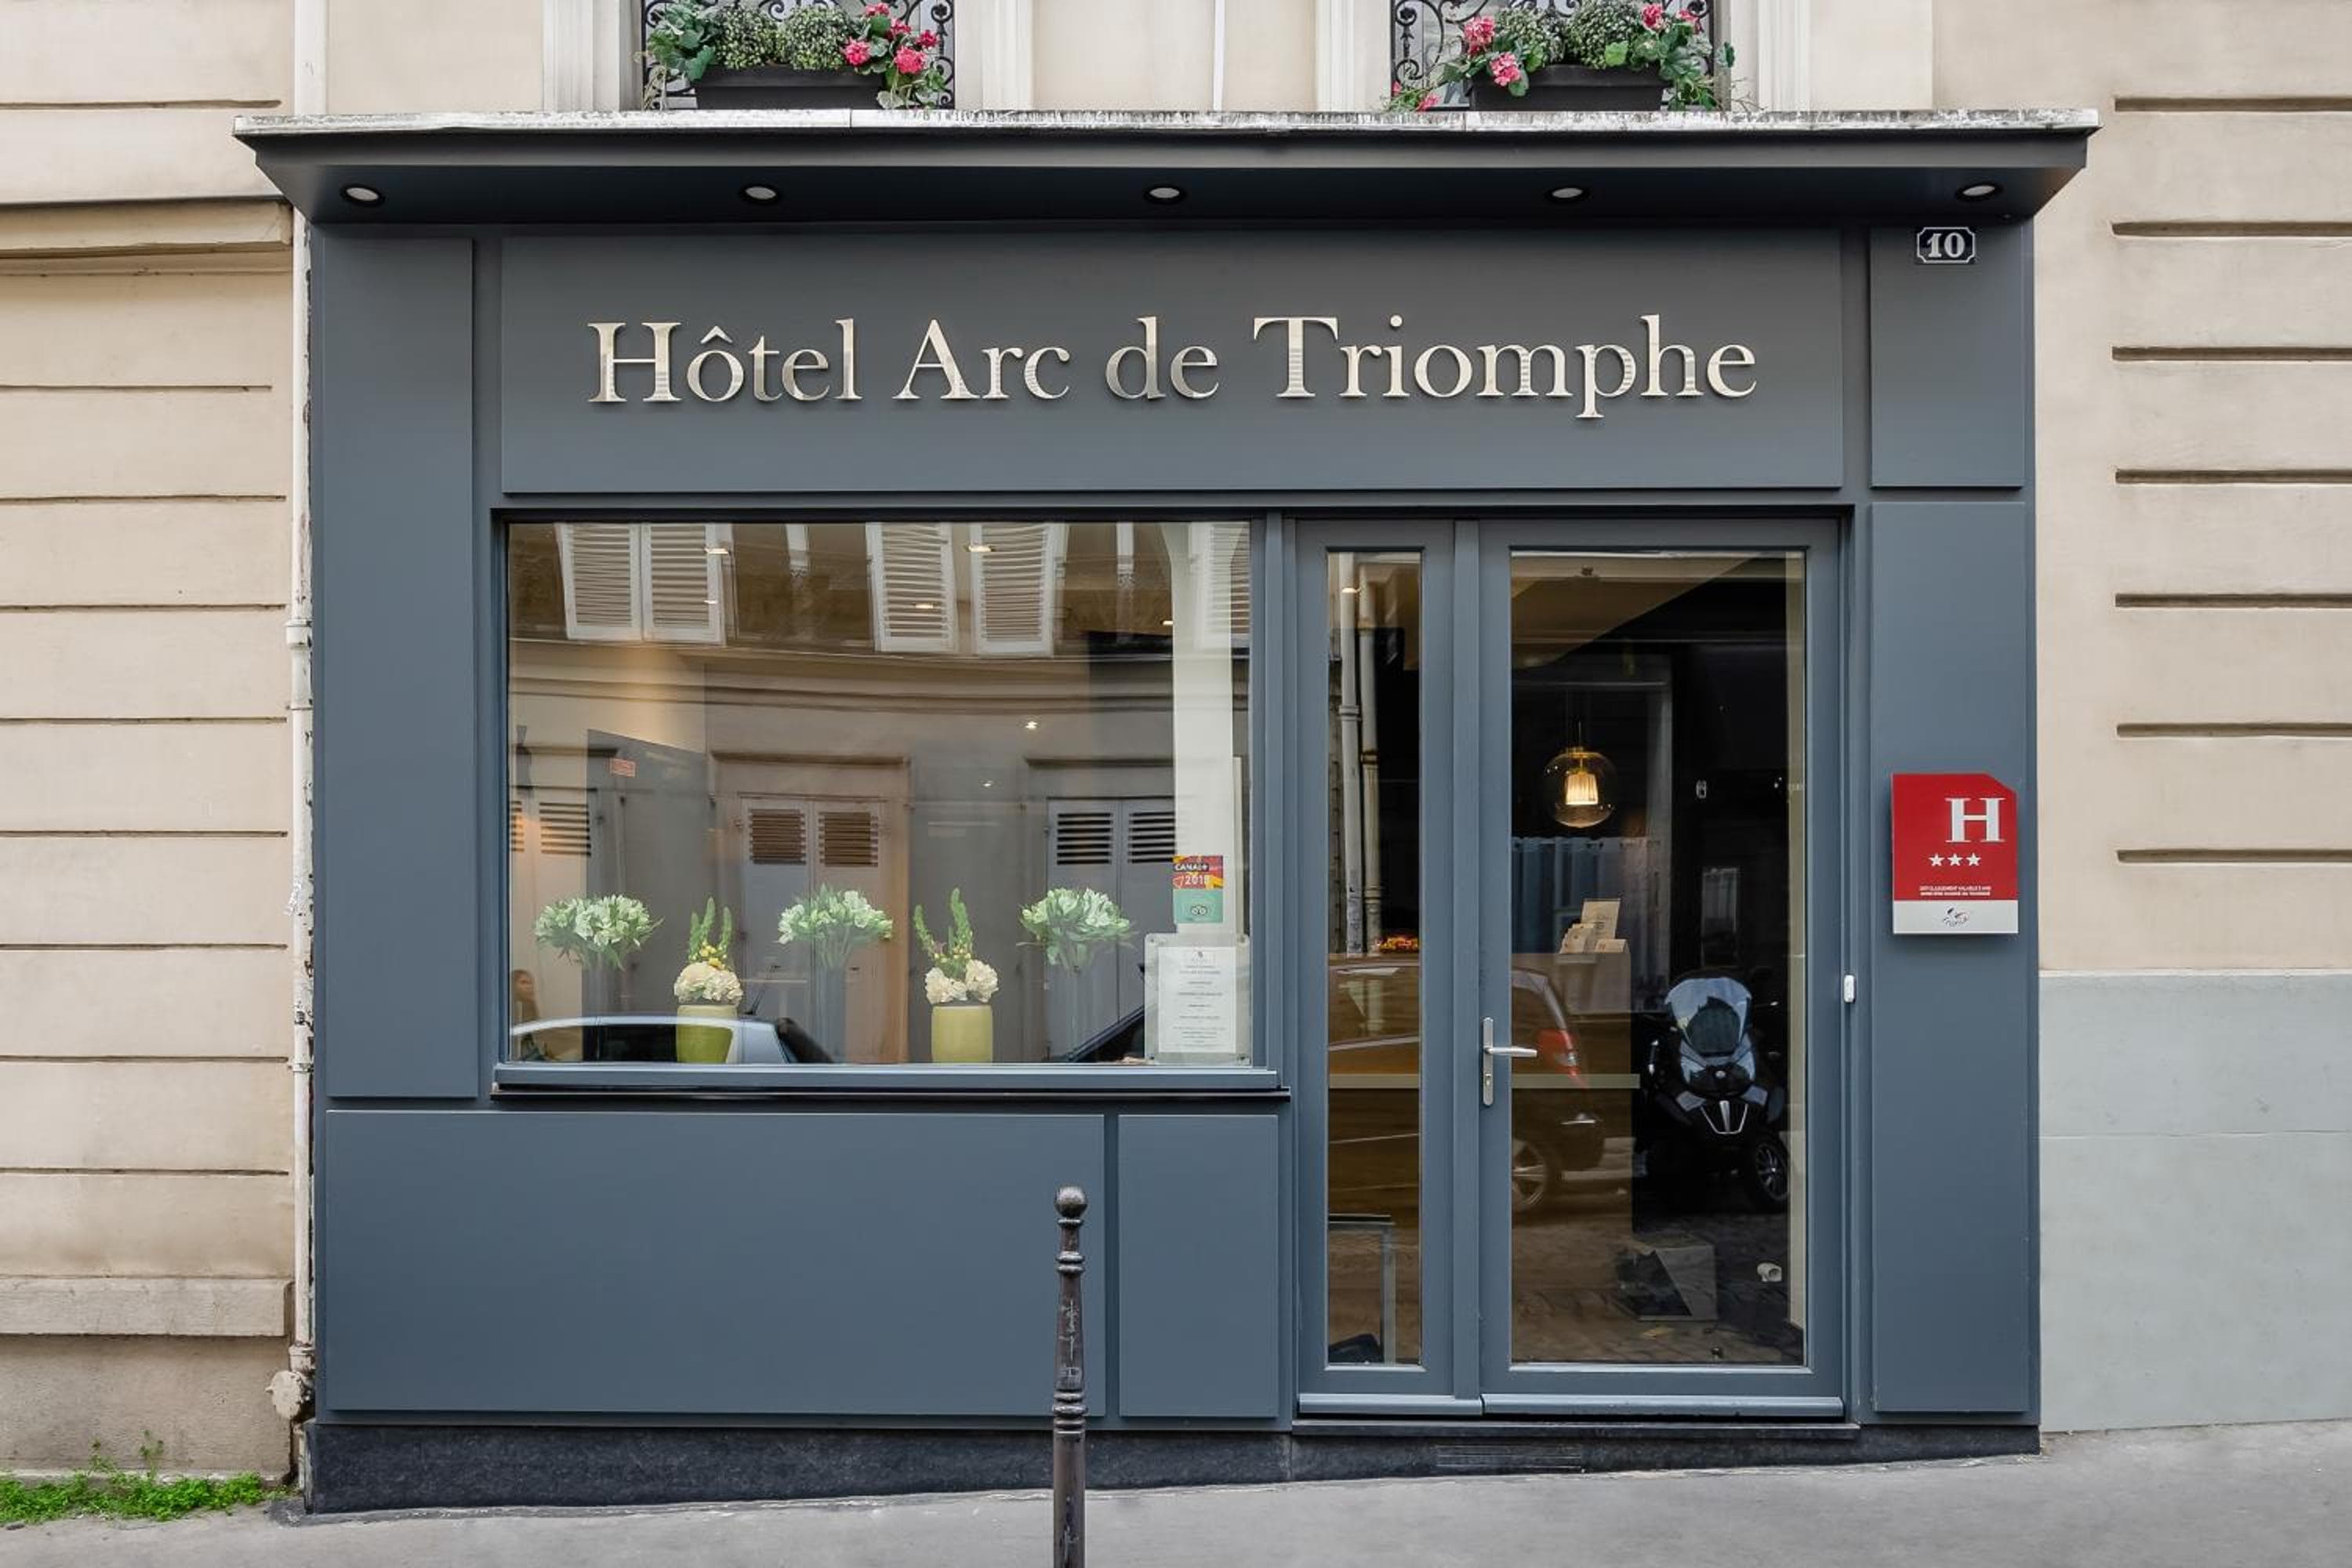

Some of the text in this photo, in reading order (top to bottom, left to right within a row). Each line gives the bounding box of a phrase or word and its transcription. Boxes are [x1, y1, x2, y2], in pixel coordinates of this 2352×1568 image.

[1927, 232, 1965, 258] 10
[588, 314, 1758, 418] Hôtel Arc de Triomphe
[1944, 797, 2006, 843] H
